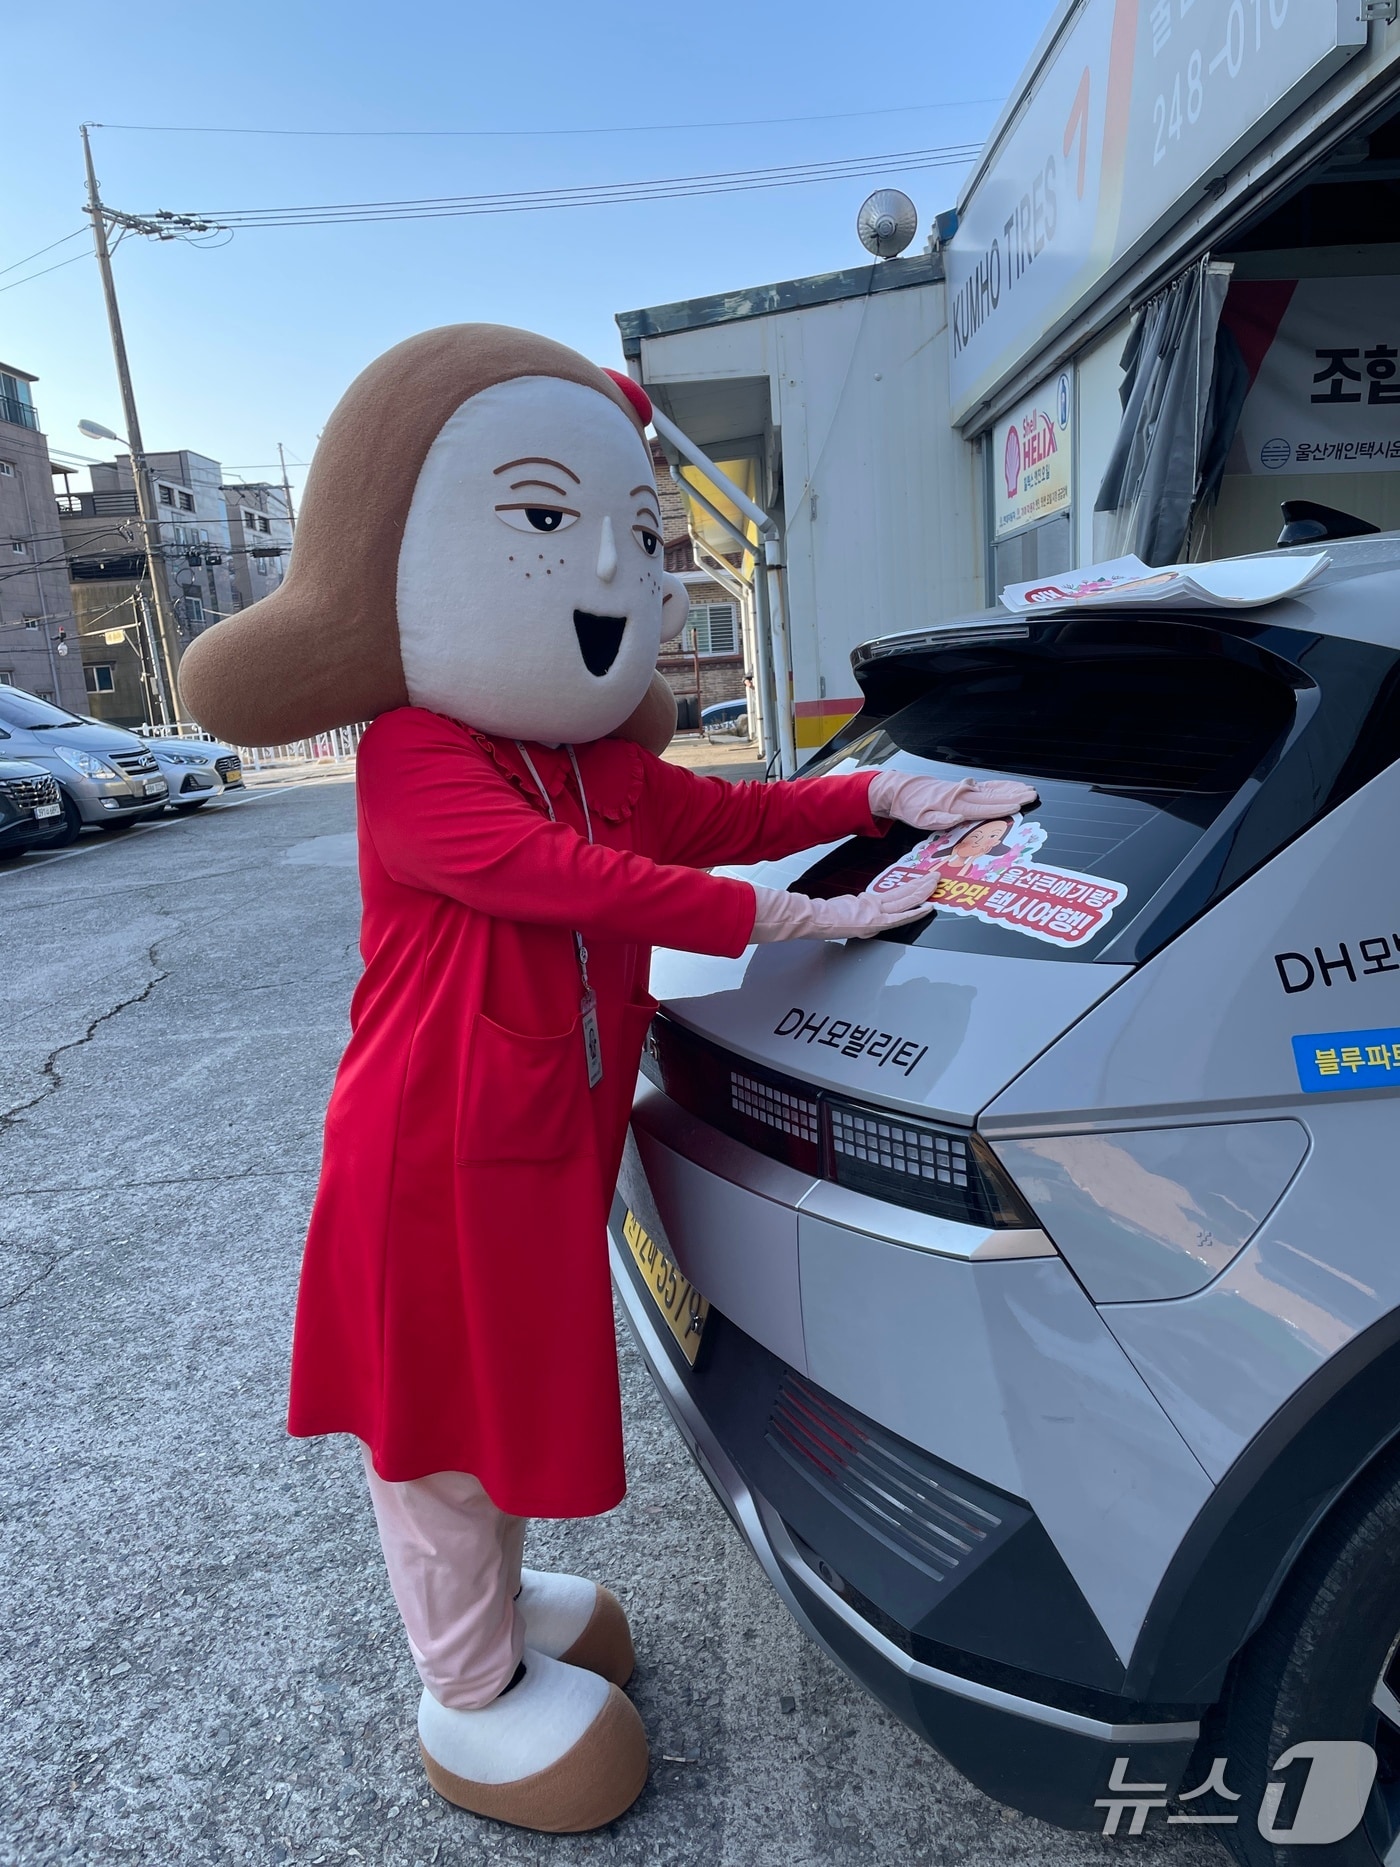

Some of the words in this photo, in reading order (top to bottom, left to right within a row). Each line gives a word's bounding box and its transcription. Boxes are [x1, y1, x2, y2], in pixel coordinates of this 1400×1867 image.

[953, 238, 1000, 358] KUMHO
[1004, 154, 1057, 290] TIRES
[1023, 408, 1037, 438] Shell
[1023, 422, 1055, 471] HELIX
[999, 866, 1112, 908] 울산큰애기랑
[984, 890, 1094, 936] 택시여행!
[774, 1008, 929, 1077] DH모빌리티
